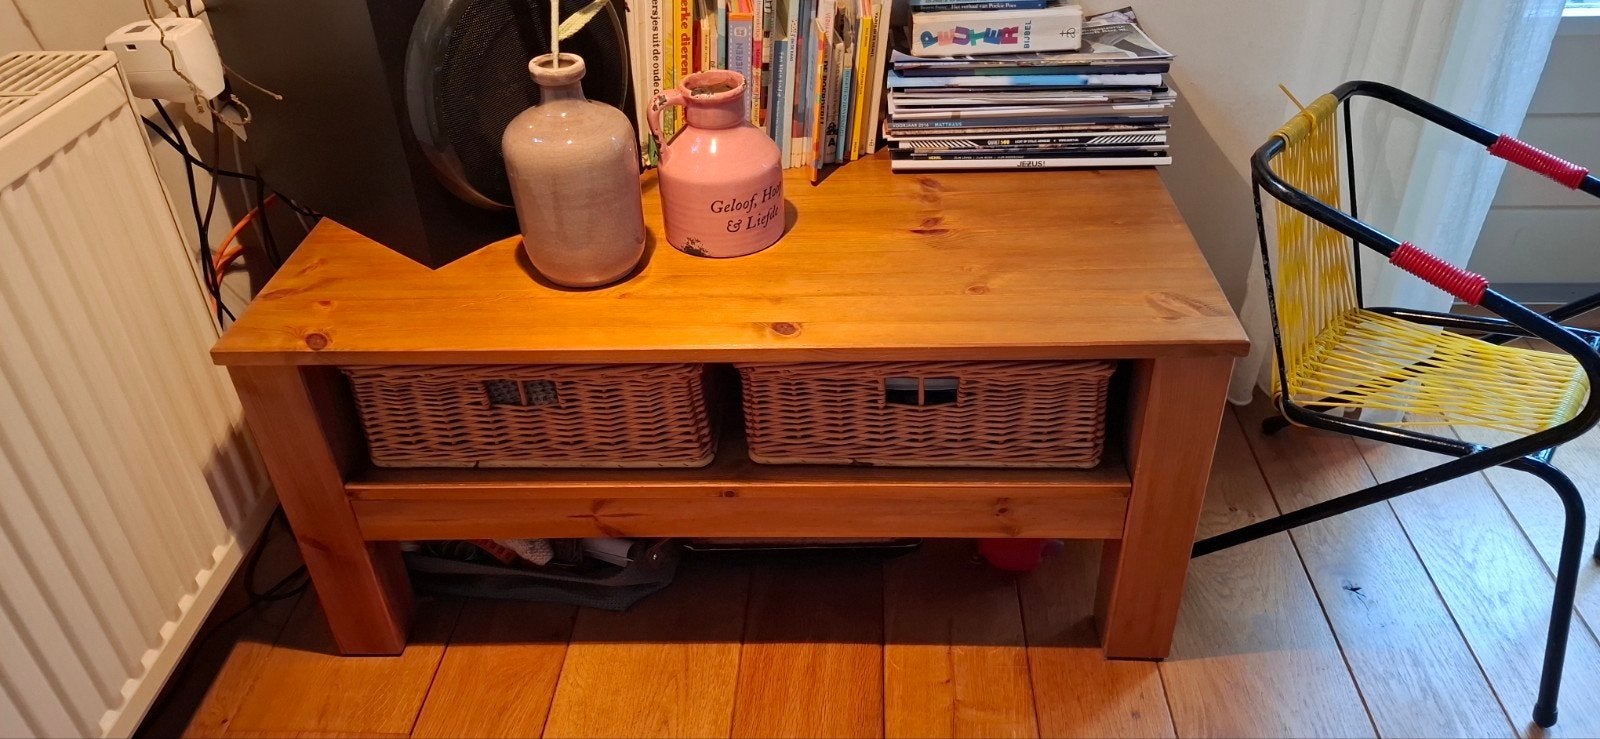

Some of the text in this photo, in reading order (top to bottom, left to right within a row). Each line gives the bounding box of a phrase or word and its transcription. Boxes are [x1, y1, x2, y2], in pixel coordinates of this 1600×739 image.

[652, 33, 661, 48] uit
[920, 26, 1019, 48] PEUTER
[1023, 20, 1032, 49] BIJBEL
[652, 49, 661, 62] de
[680, 33, 691, 76] dieren
[652, 63, 661, 88] oude
[710, 193, 758, 214] Geloof,
[726, 220, 742, 233] &
